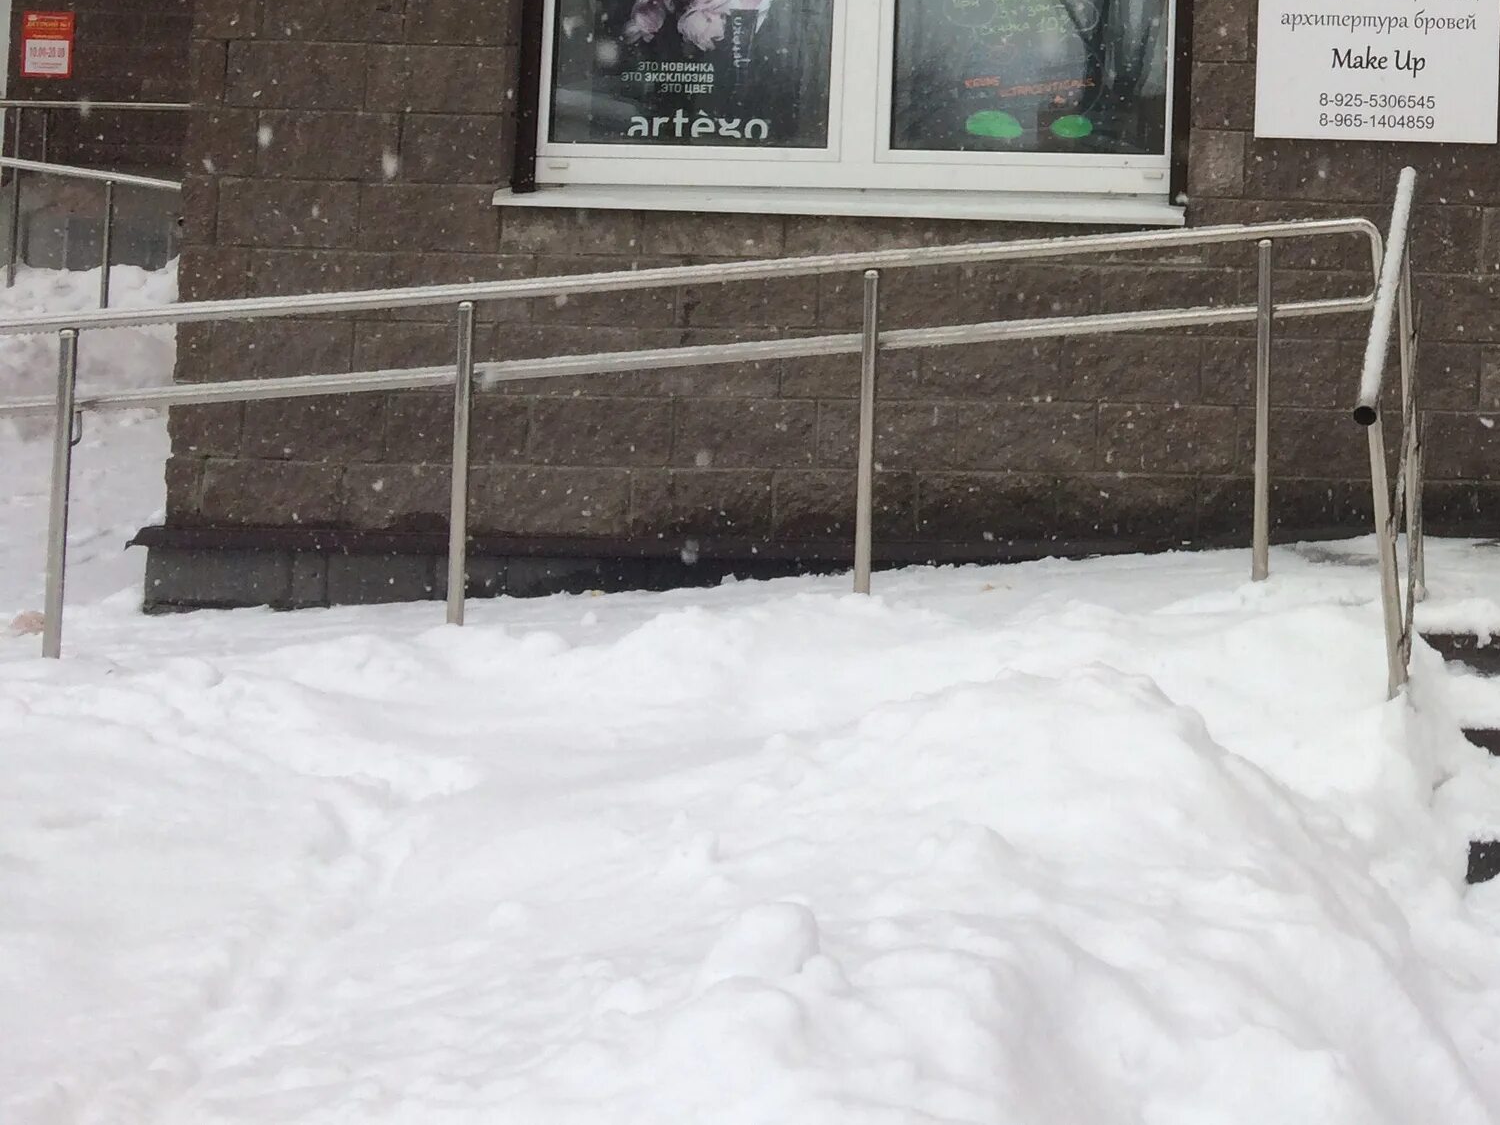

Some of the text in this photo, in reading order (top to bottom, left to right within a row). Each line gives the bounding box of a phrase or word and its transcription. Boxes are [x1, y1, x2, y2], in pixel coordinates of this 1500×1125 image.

[1413, 9, 1477, 34] бровей
[638, 62, 714, 72] ЭТО НОВИНКА
[1331, 46, 1426, 78] Make Up
[621, 72, 714, 83] ЭТО ЭКСКЛЮЗИВ
[661, 83, 714, 95] ЭТО ЦВЕТ
[1319, 92, 1436, 110] 8-925-5306545
[1319, 112, 1435, 130] 8-965-1404859
